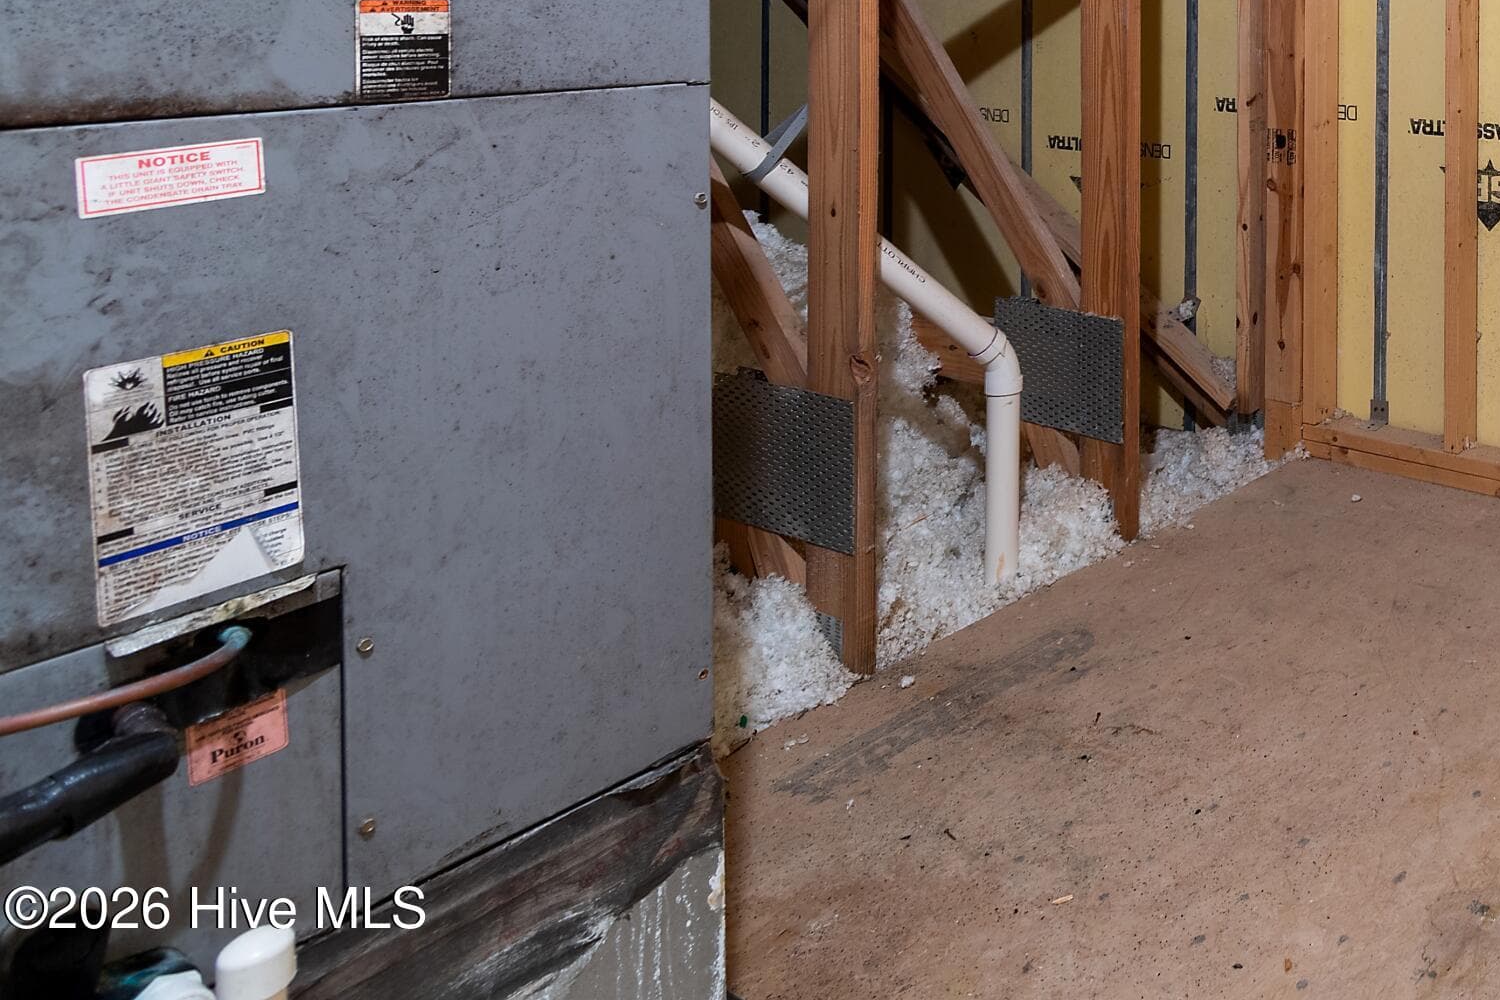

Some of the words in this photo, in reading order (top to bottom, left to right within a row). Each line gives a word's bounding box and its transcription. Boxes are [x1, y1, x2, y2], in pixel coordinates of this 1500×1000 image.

[109, 172, 130, 181] THIS
[132, 169, 155, 179] UNIT
[168, 163, 213, 174] EQUIPPED
[216, 159, 238, 168] WITH
[138, 151, 212, 169] NOTICE
[108, 190, 115, 198] IF
[119, 186, 141, 197] UNIT
[143, 182, 173, 193] SHUTS
[208, 175, 240, 184] CHECK
[110, 179, 140, 190] LITTLE
[105, 196, 123, 206] THE
[126, 189, 189, 203] CONDENSATE
[191, 185, 219, 194] DRAIN
[220, 339, 265, 354] CAUTION
[188, 355, 230, 369] PRESSURE
[232, 348, 264, 359] HAZARD
[200, 362, 227, 374] pressure
[240, 355, 263, 363] recover
[200, 369, 221, 378] before
[221, 365, 243, 376] system
[244, 361, 262, 371] repair
[270, 355, 283, 363] final
[198, 378, 211, 386] Use
[221, 371, 242, 380] service
[168, 392, 187, 402] FIRE
[188, 385, 222, 398] HAZARD
[179, 401, 190, 409] not
[191, 398, 203, 406] use
[203, 394, 220, 403] torch
[228, 387, 251, 398] remove
[251, 379, 288, 392] components.
[179, 407, 193, 417] may
[194, 403, 211, 412] catch
[225, 397, 237, 405] use
[237, 392, 257, 403] tubing
[195, 408, 218, 418] service
[156, 413, 232, 438] INSTALLATION
[178, 503, 221, 521] SERVICE
[183, 525, 222, 543] NOTICE
[210, 735, 265, 764] Puron
